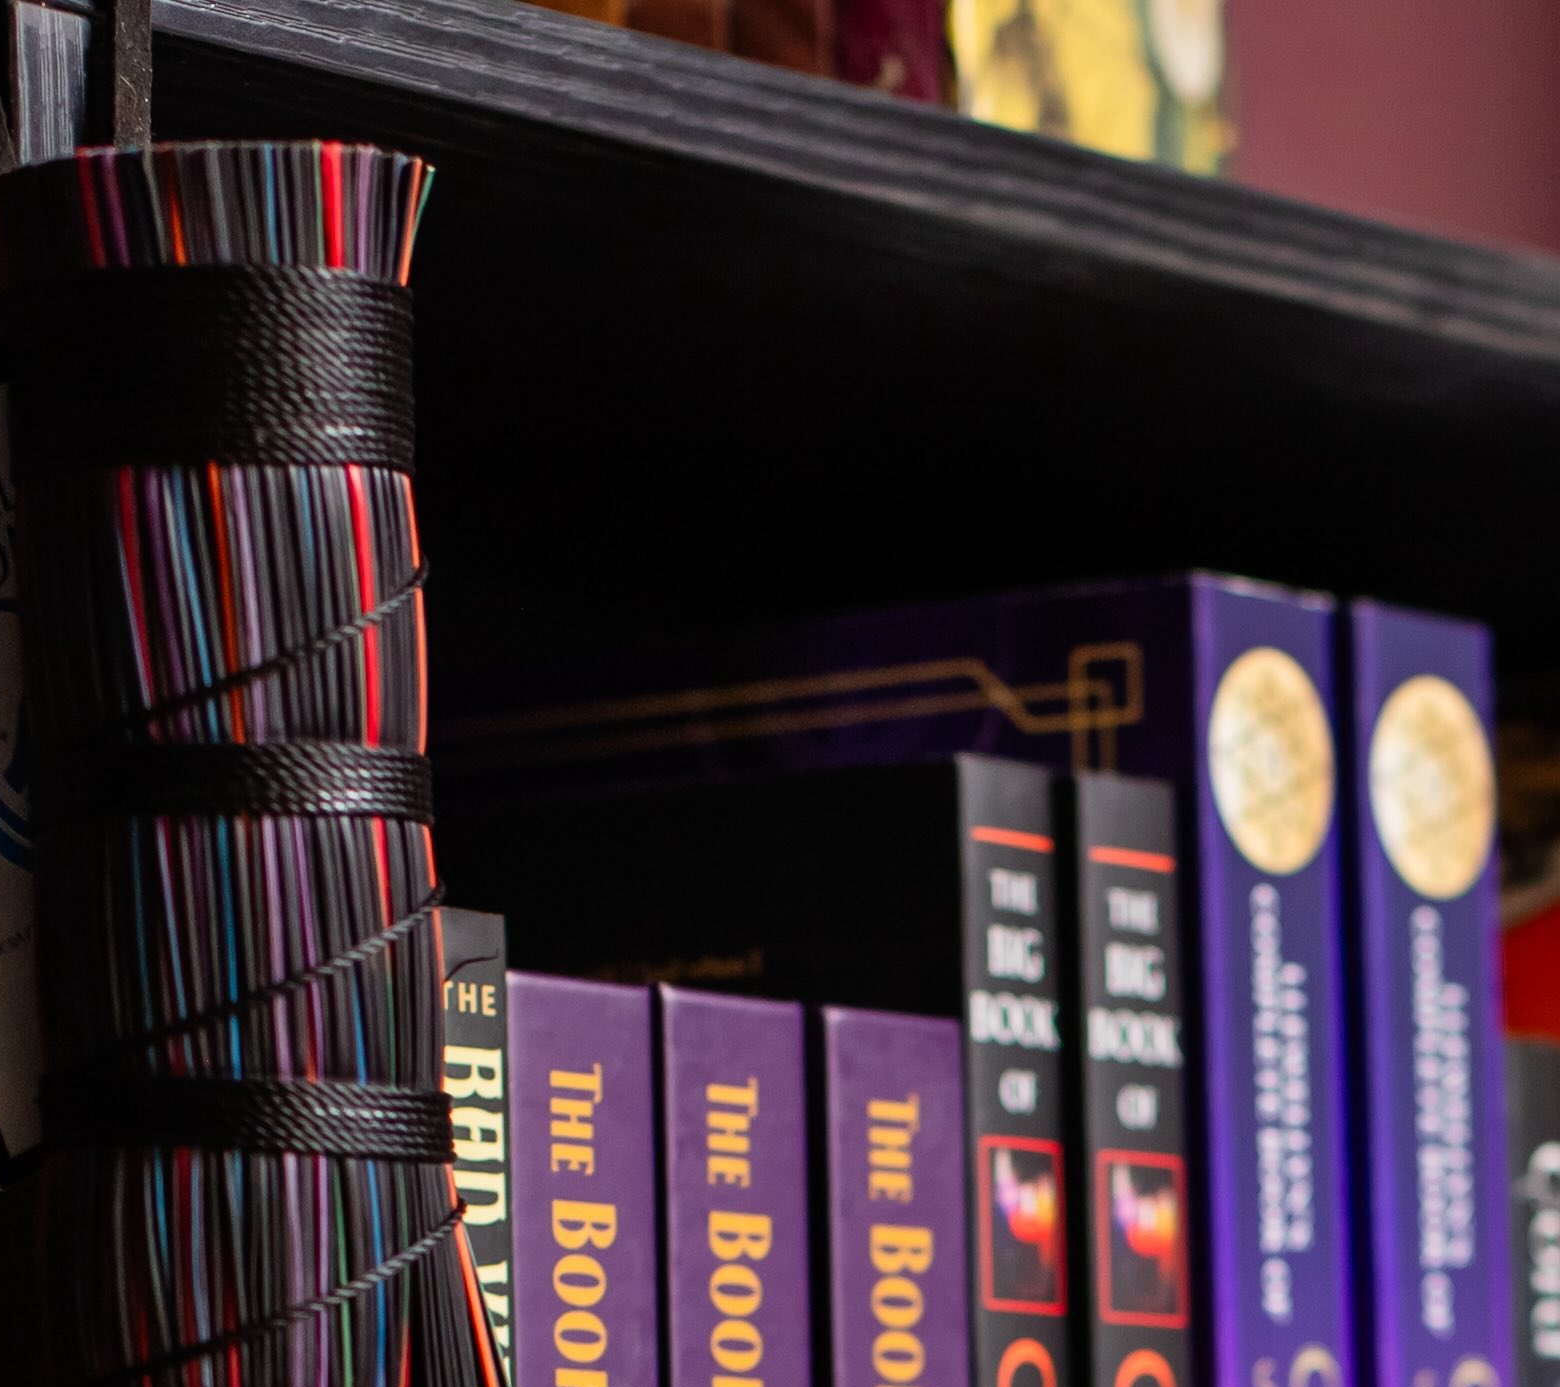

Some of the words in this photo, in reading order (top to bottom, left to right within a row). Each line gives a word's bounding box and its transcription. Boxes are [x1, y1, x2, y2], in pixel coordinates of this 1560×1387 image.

[987, 867, 1039, 916] THE
[1105, 885, 1160, 936] THE
[985, 922, 1046, 983] BIG
[1103, 940, 1168, 1002] BIG
[442, 977, 497, 1016] THE
[969, 988, 1060, 1050] BOOK
[1086, 1007, 1182, 1068] BOOK
[549, 1063, 603, 1174] THE
[706, 1078, 758, 1187] THE
[869, 1096, 919, 1198] THE
